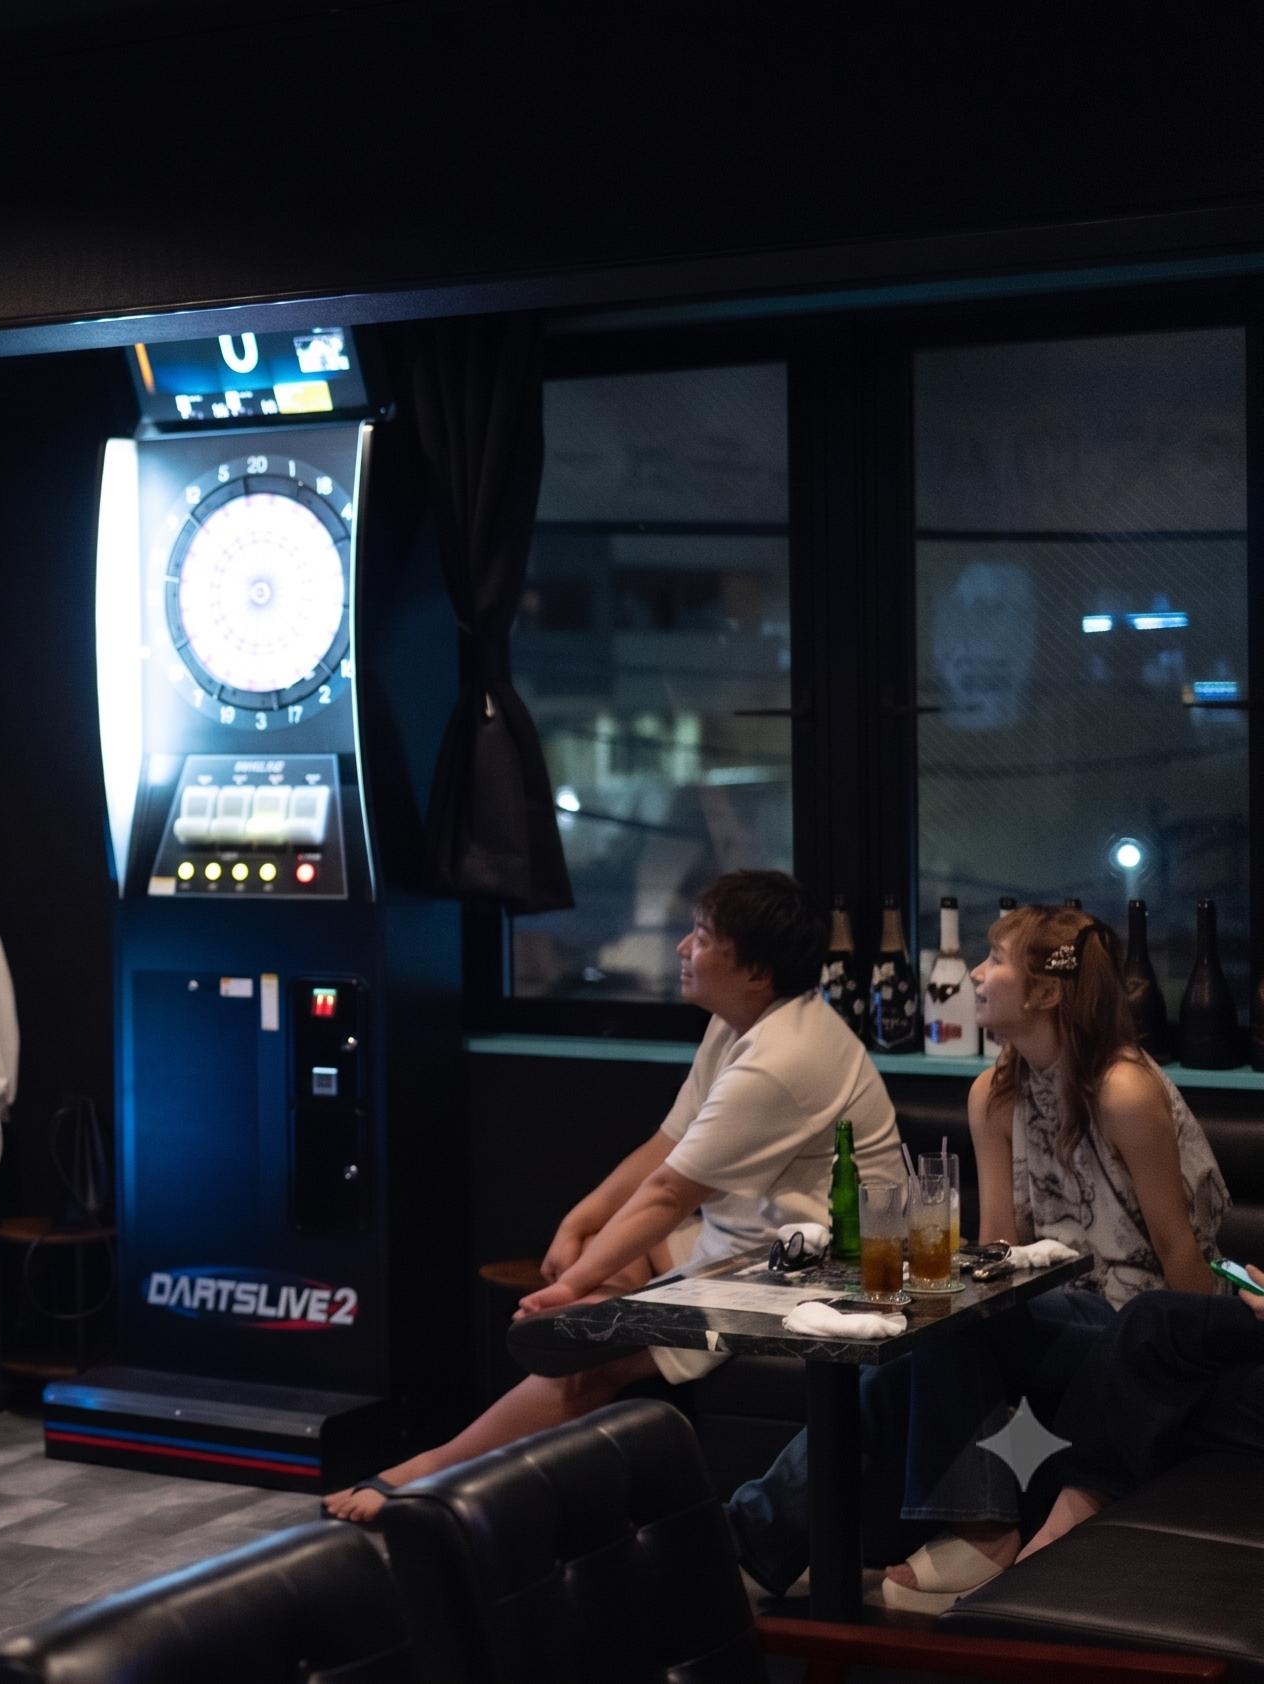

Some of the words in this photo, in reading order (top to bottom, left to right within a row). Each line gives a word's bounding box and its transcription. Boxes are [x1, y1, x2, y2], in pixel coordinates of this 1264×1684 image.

[218, 464, 230, 482] 5
[247, 455, 268, 474] 20
[288, 460, 296, 477] 1
[316, 476, 333, 495] 18
[319, 685, 331, 704] 2
[220, 706, 235, 724] 19
[255, 711, 267, 730] 3
[288, 705, 303, 723] 17
[147, 1272, 358, 1326] DARTSLIVE2
